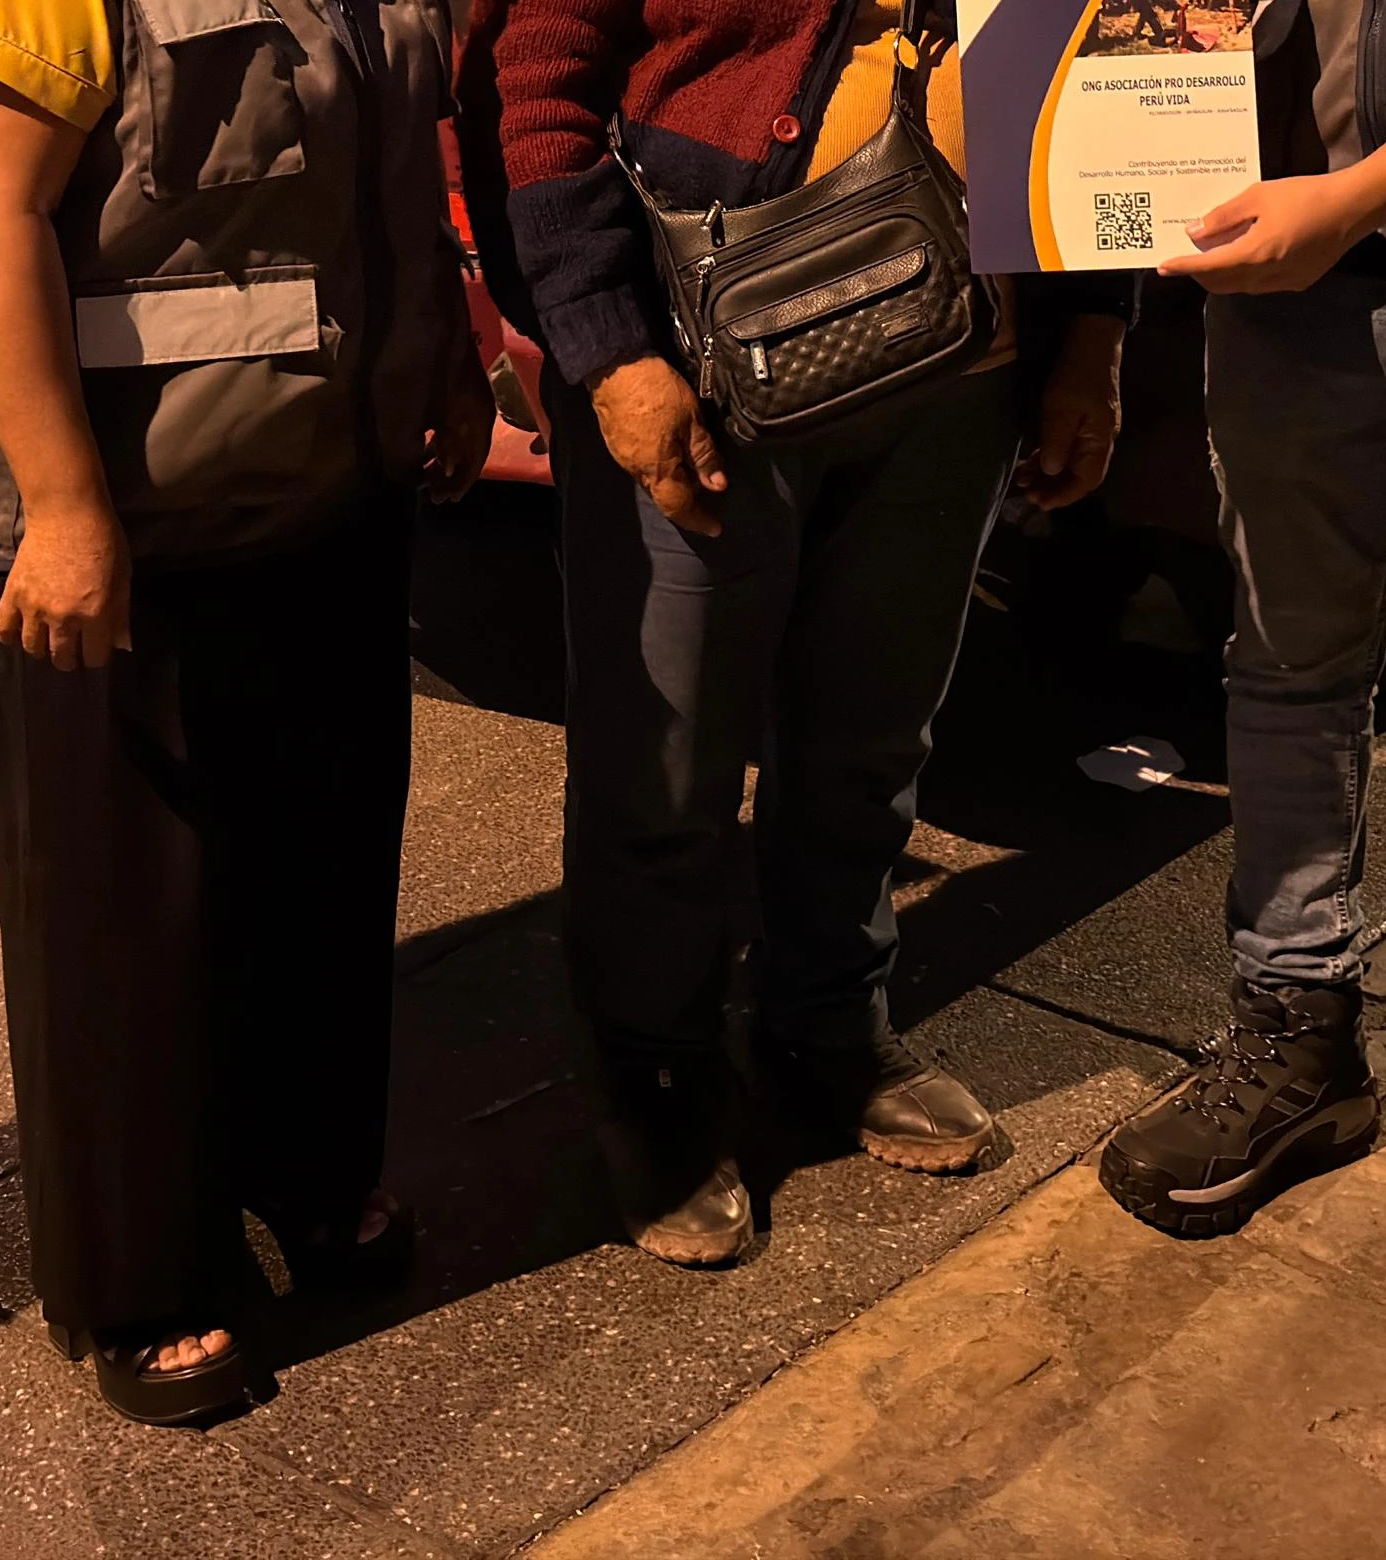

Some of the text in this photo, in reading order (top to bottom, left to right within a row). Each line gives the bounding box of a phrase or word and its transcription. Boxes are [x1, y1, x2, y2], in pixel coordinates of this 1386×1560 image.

[1081, 75, 1246, 92] ONG ASOCIACIÓN PRO DESARROLLO
[1139, 92, 1191, 107] PERÚ VIDA
[1128, 159, 1177, 169] Contribuyendo
[1190, 158, 1197, 166] la
[1198, 157, 1234, 166] Promoción
[1235, 156, 1247, 164] del
[1078, 170, 1114, 178] Desarrollo
[1147, 168, 1168, 176] Social
[1175, 167, 1211, 175] Sostenible
[1231, 165, 1247, 173] Perú
